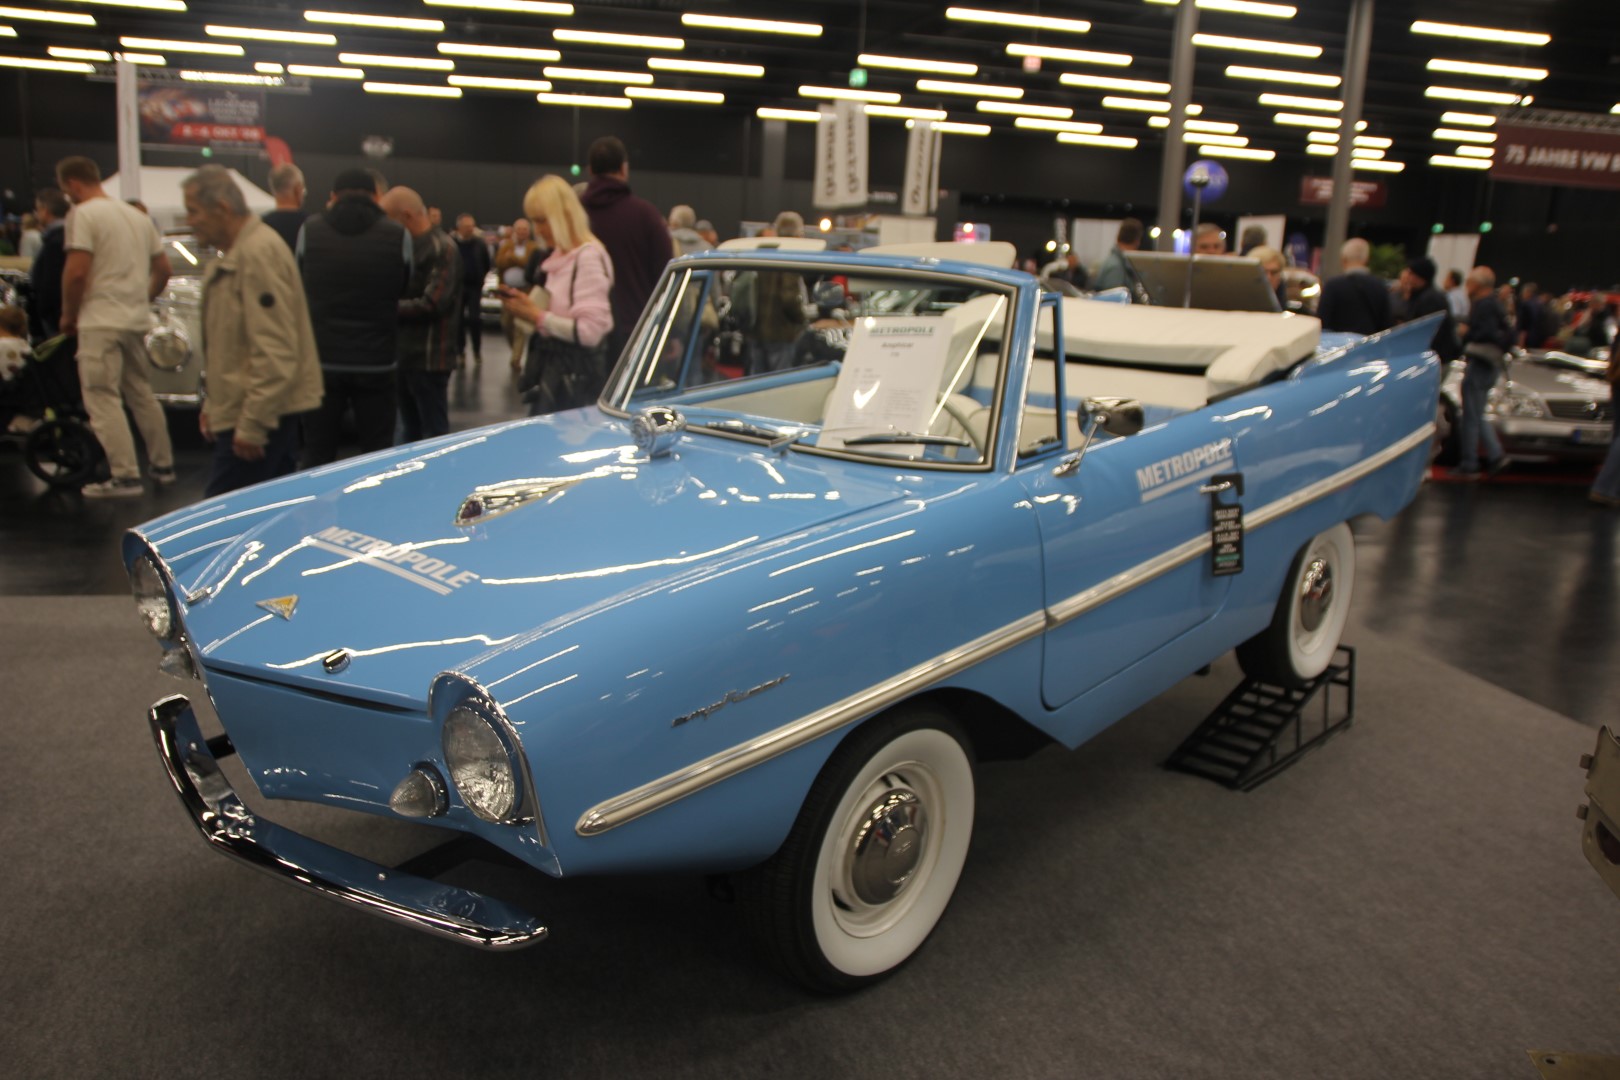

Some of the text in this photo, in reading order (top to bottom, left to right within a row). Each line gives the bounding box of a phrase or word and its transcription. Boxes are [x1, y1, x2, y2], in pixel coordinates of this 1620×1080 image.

[1504, 144, 1526, 165] 75
[1526, 146, 1580, 169] JAHRE
[1581, 150, 1612, 171] VW
[1136, 437, 1233, 491] METROPOLE
[315, 526, 481, 588] METROPOLE
